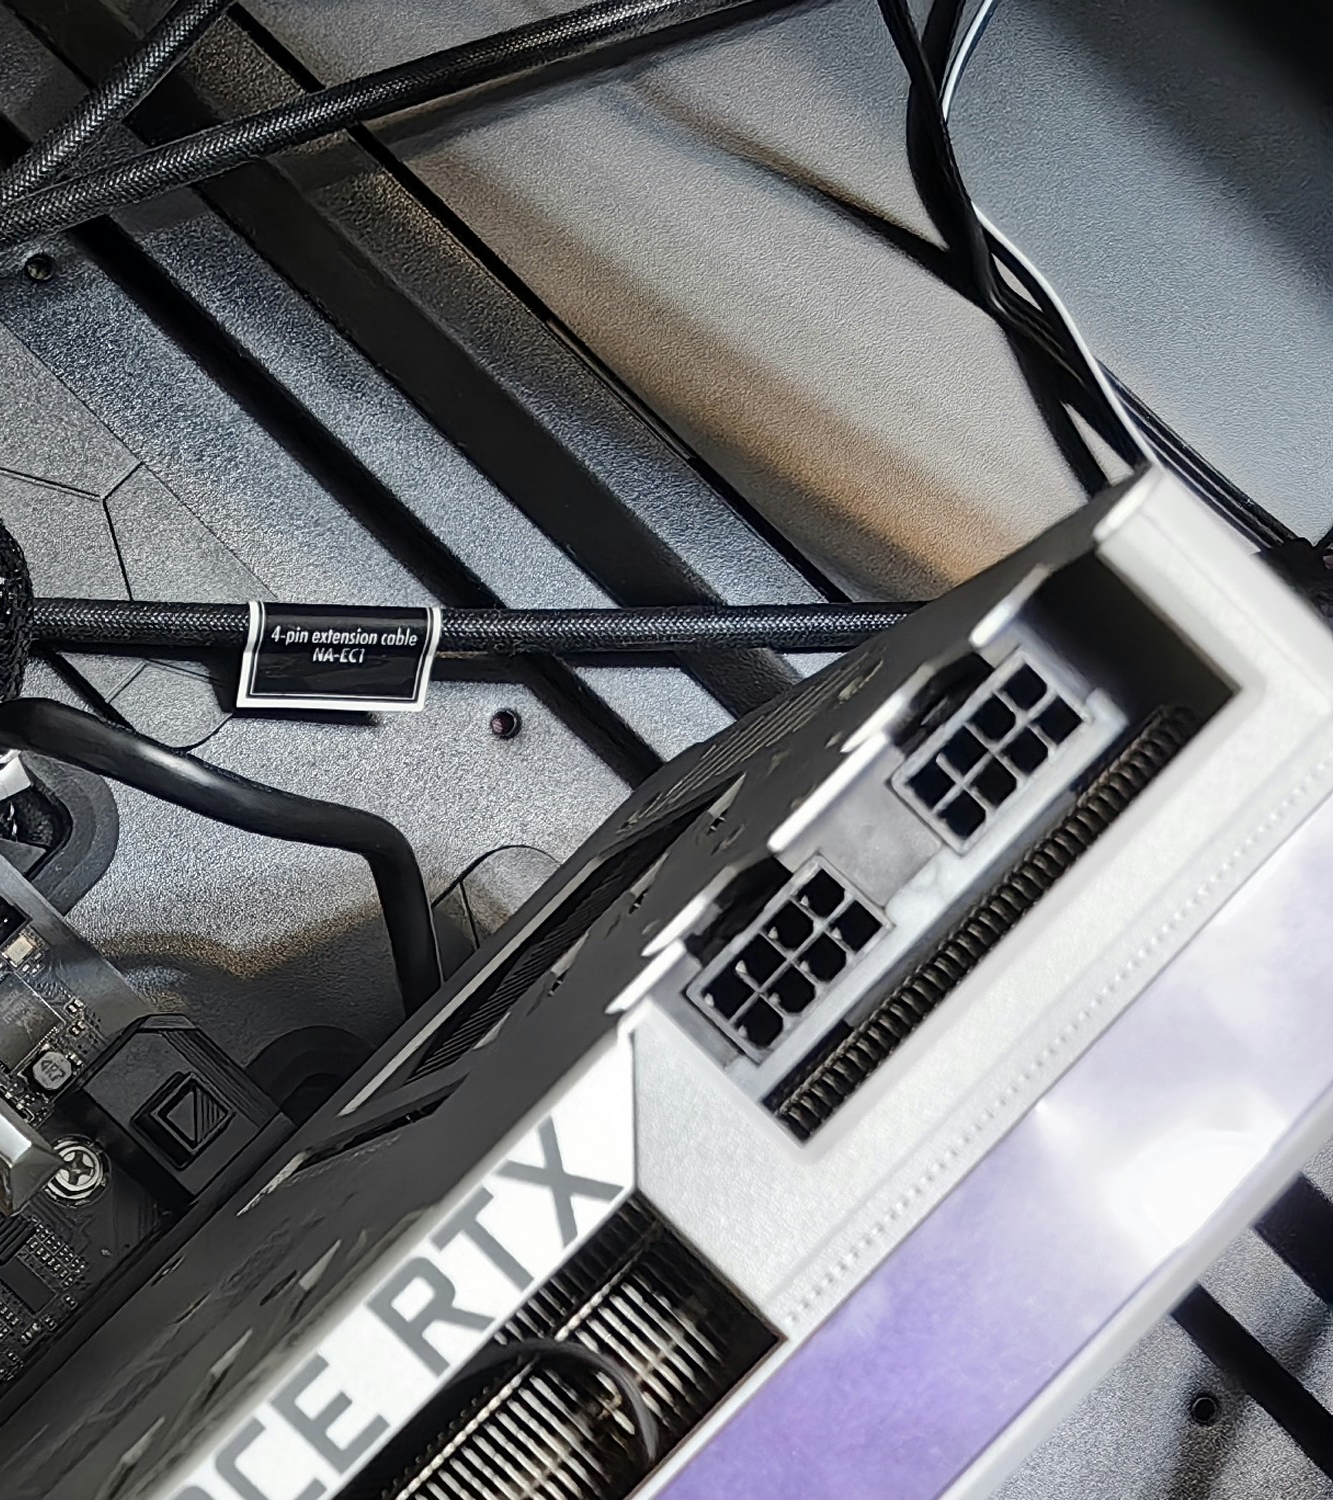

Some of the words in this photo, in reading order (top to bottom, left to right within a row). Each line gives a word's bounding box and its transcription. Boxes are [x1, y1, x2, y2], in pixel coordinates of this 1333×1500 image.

[271, 625, 307, 645] 4-pin
[311, 626, 376, 645] extension
[380, 627, 417, 645] cable
[313, 647, 364, 662] NA-EC1
[367, 1116, 624, 1378] RTX
